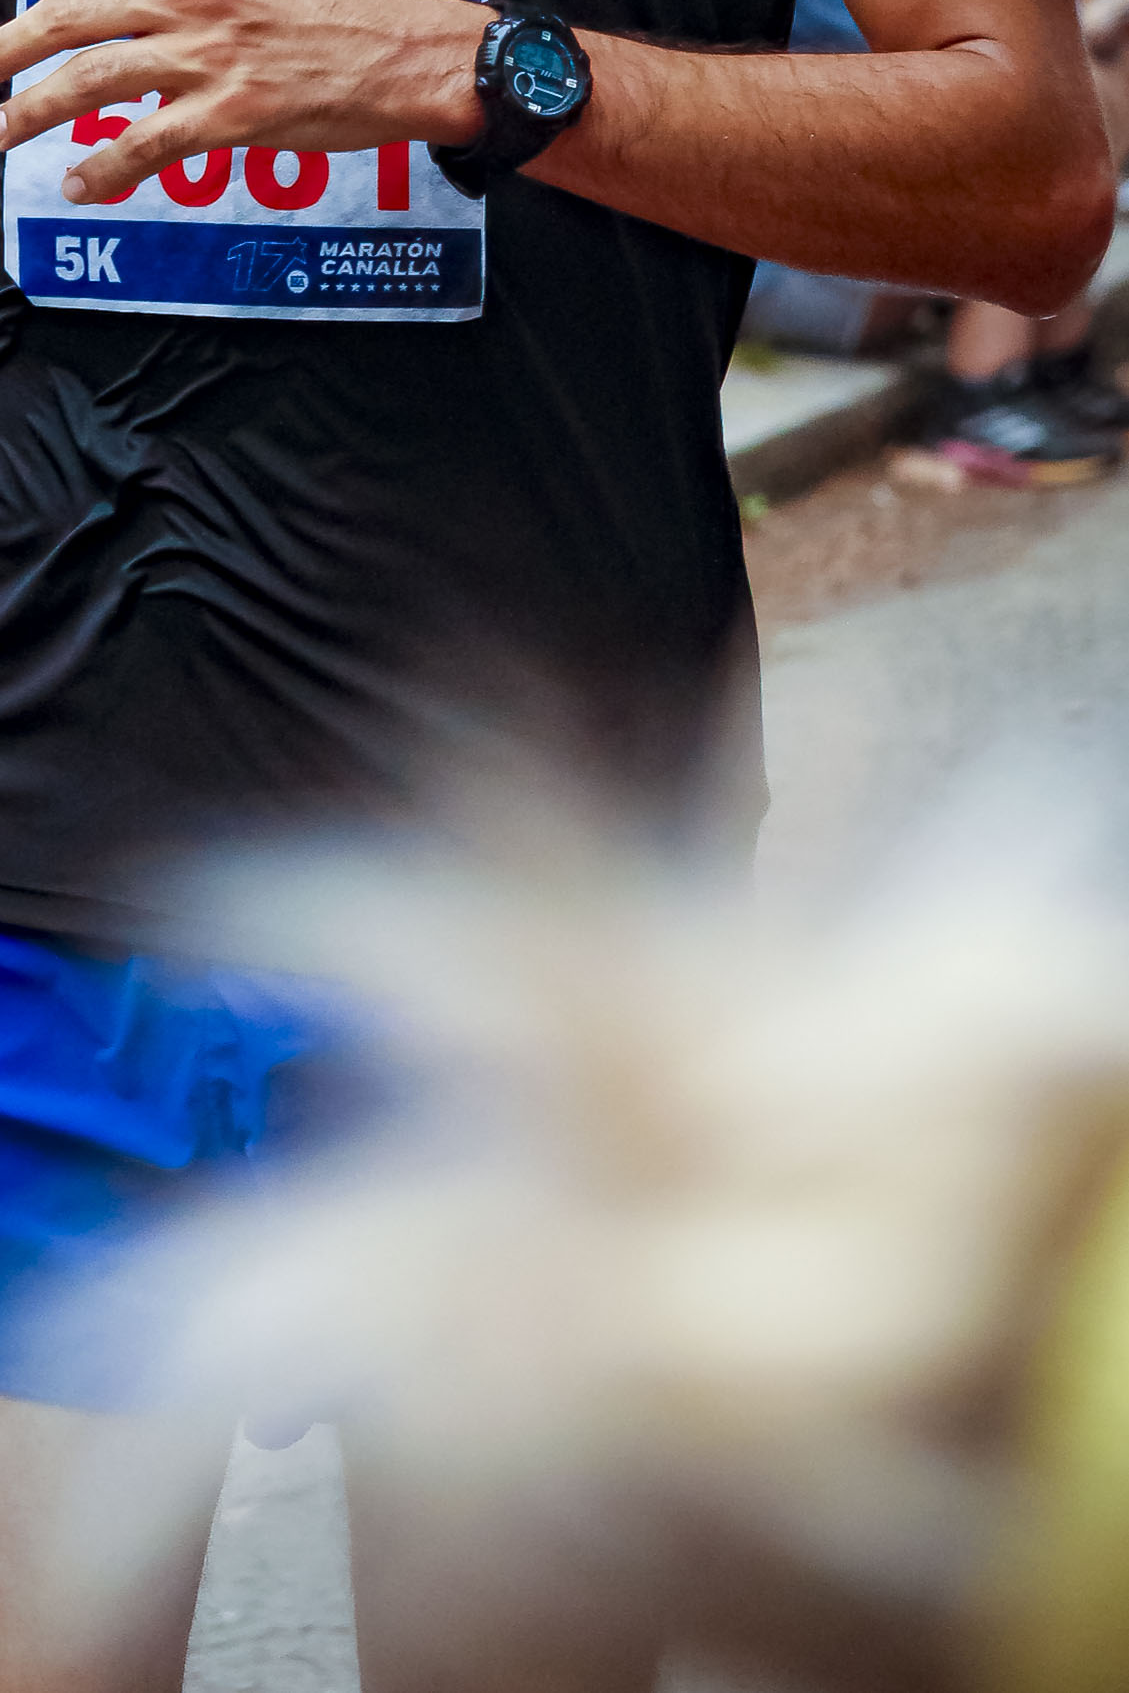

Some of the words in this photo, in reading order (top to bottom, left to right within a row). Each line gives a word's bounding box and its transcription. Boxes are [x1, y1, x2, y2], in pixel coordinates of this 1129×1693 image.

[319, 237, 442, 257] MARATÓN
[55, 235, 121, 283] 5K
[320, 260, 440, 275] CANALLA
